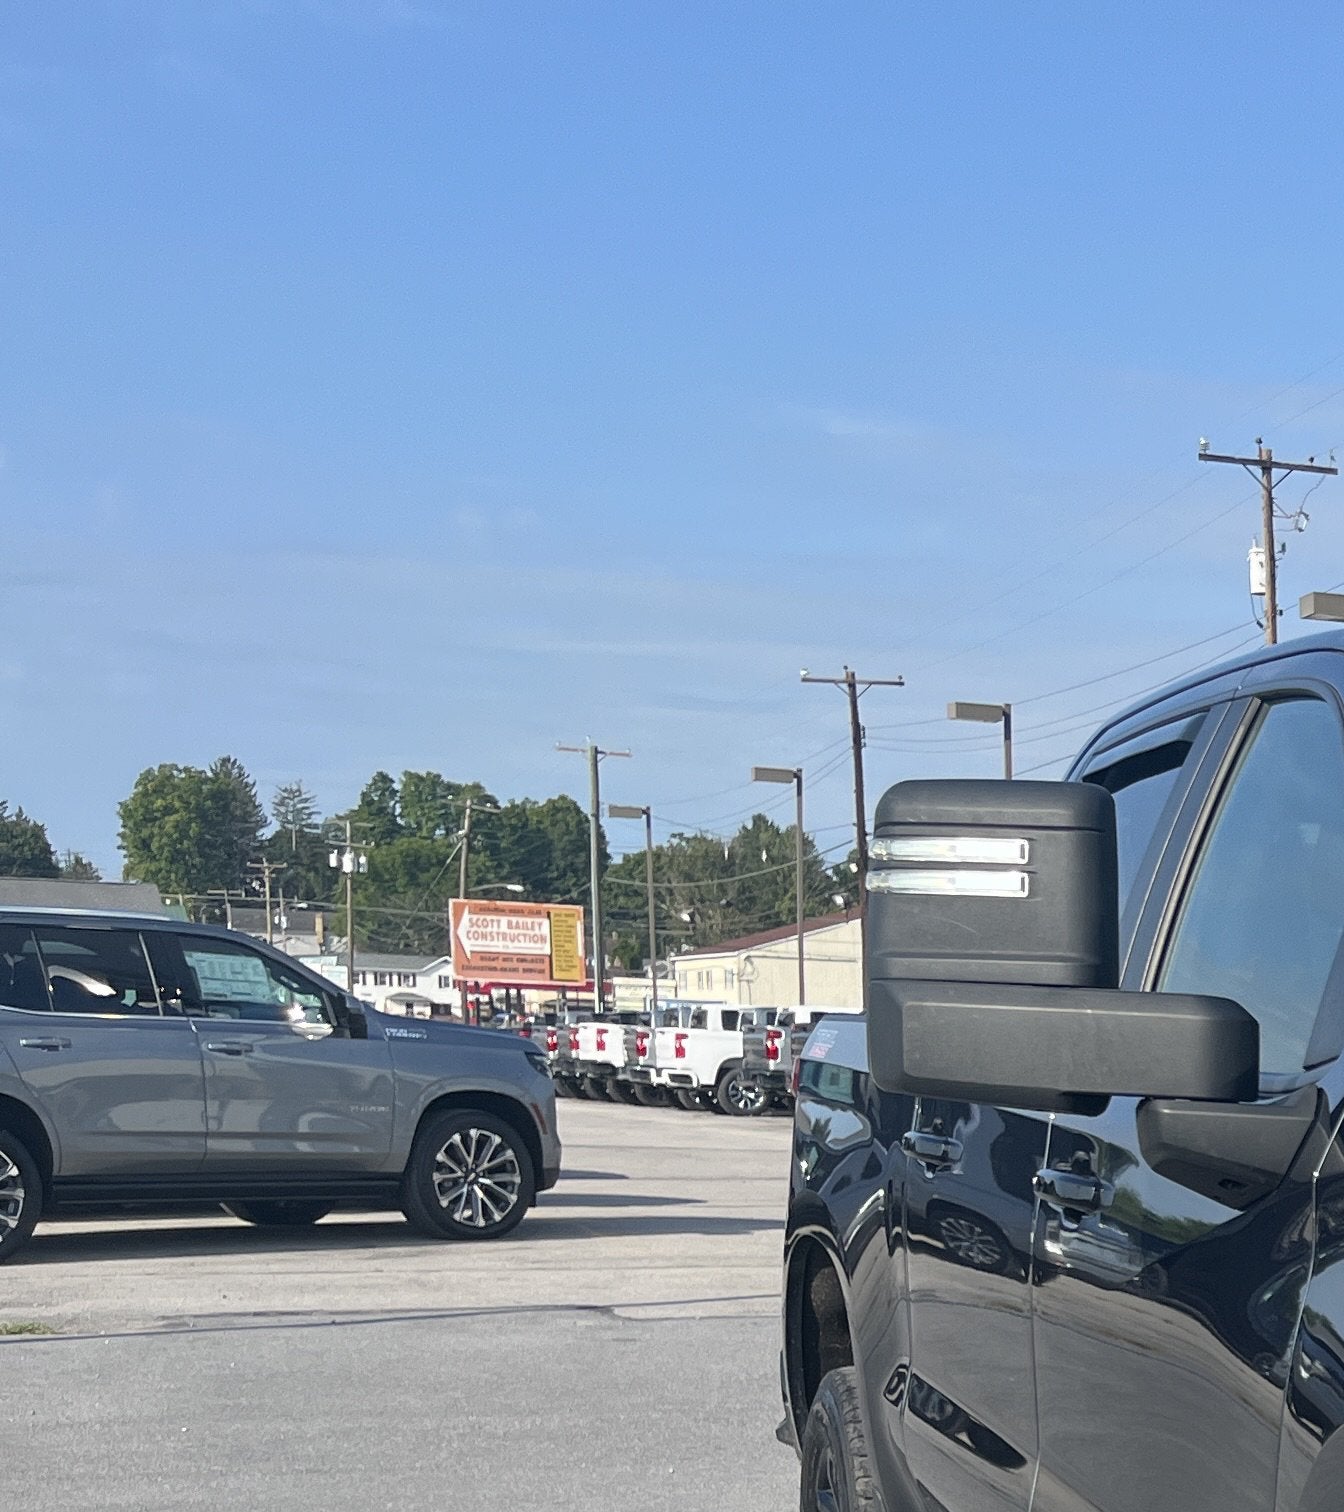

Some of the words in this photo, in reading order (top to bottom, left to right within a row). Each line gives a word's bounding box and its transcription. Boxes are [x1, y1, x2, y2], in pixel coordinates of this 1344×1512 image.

[468, 917, 501, 929] SCOTT
[507, 919, 543, 931] BAILEY
[466, 930, 548, 944] CONSTRUCTION
